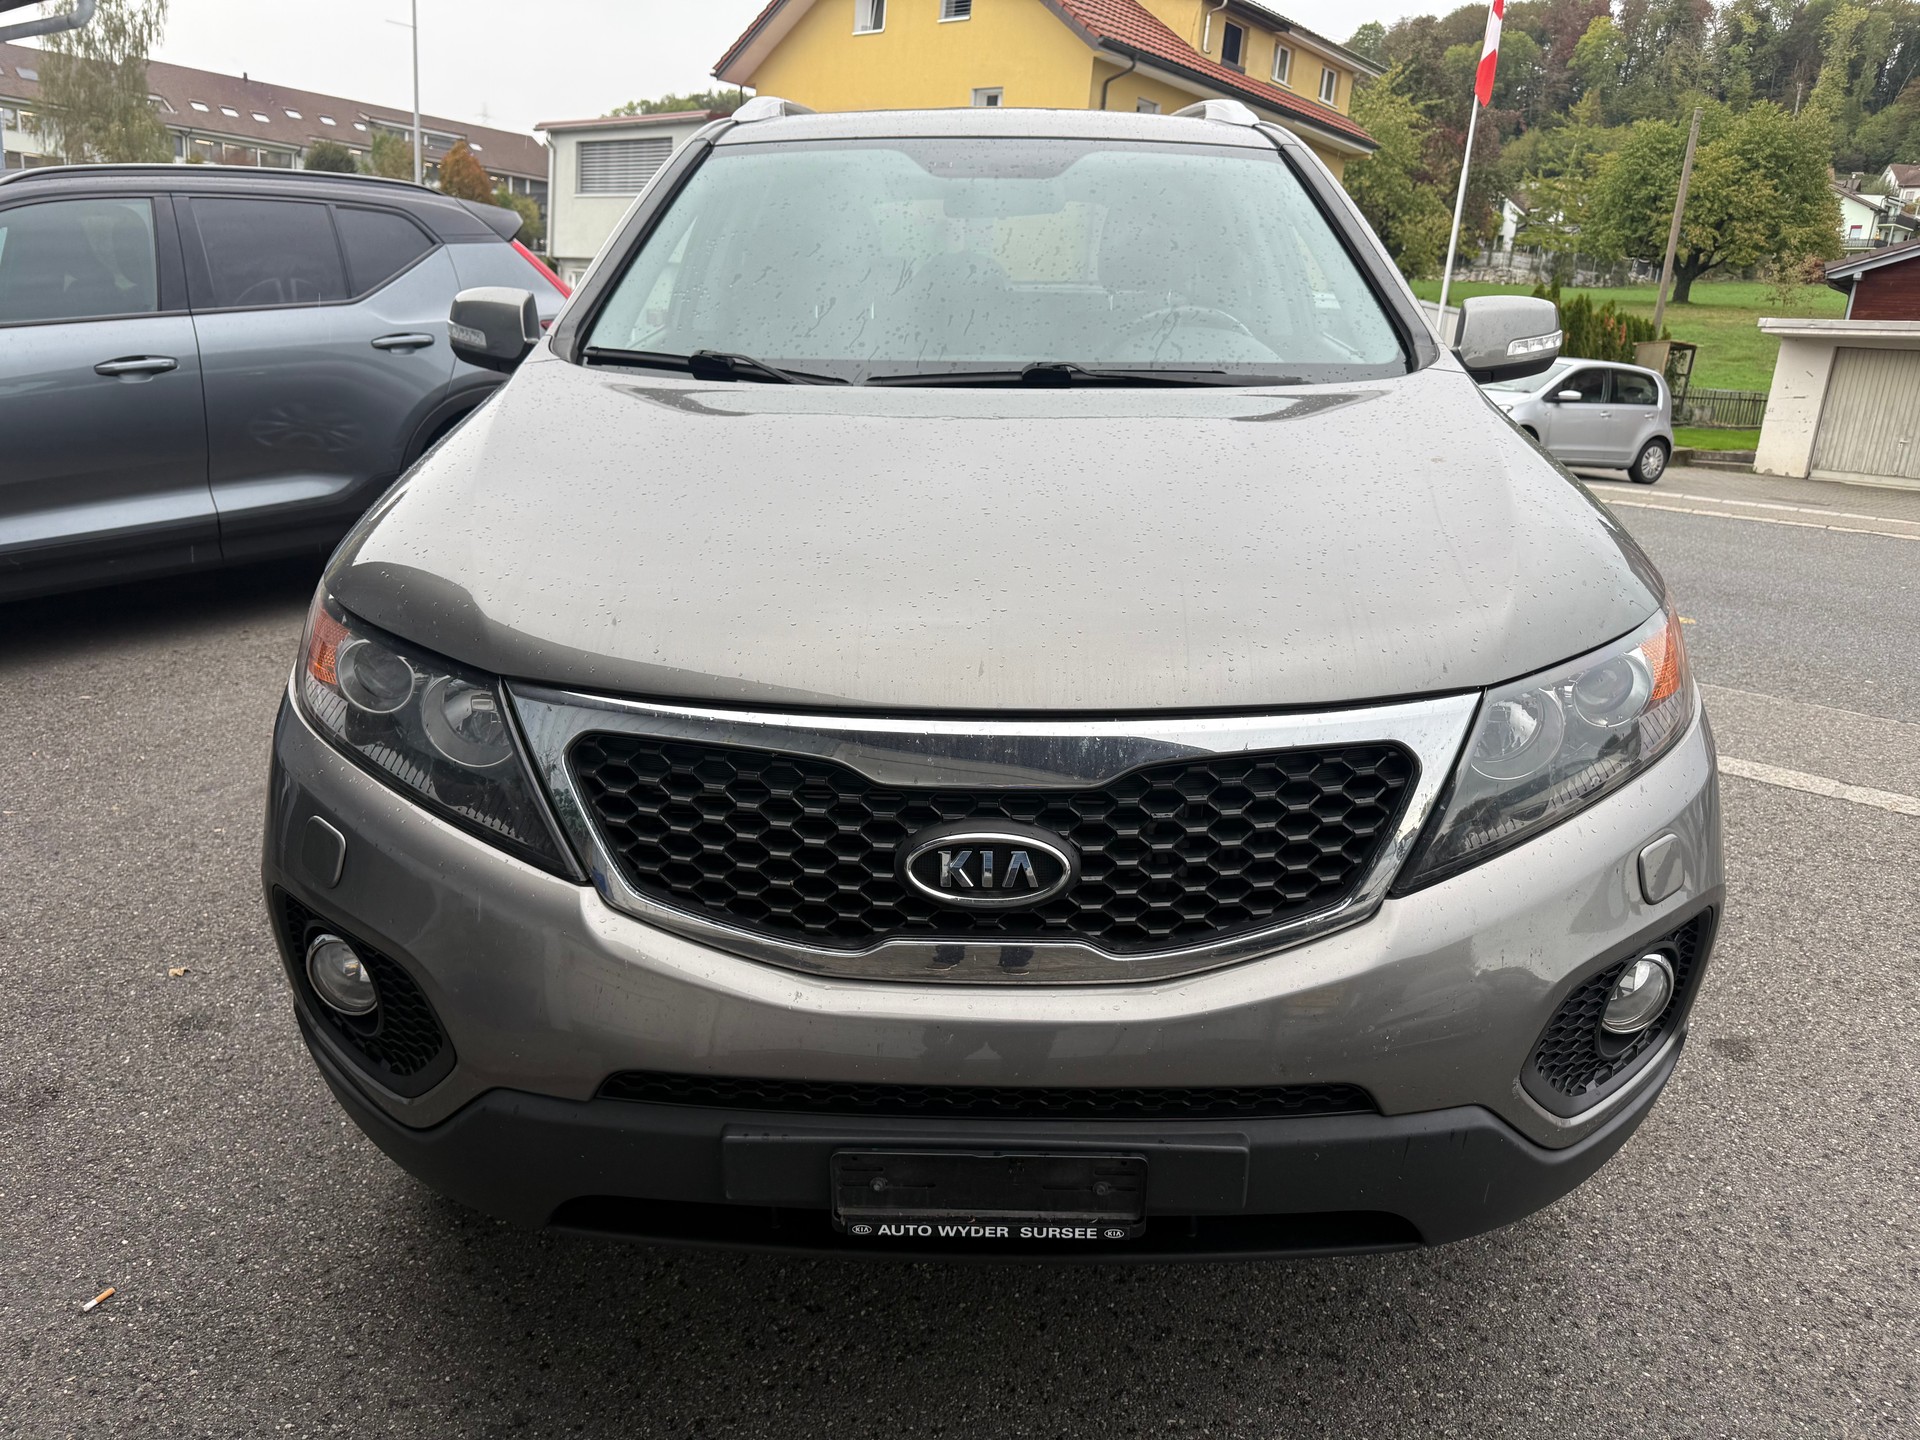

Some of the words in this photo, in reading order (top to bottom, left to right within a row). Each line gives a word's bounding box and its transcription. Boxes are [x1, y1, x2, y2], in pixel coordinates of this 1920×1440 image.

[937, 850, 1039, 888] KIA
[877, 1224, 932, 1237] AUTO
[938, 1225, 1009, 1238] WYDER
[1019, 1226, 1098, 1240] SURSEE
